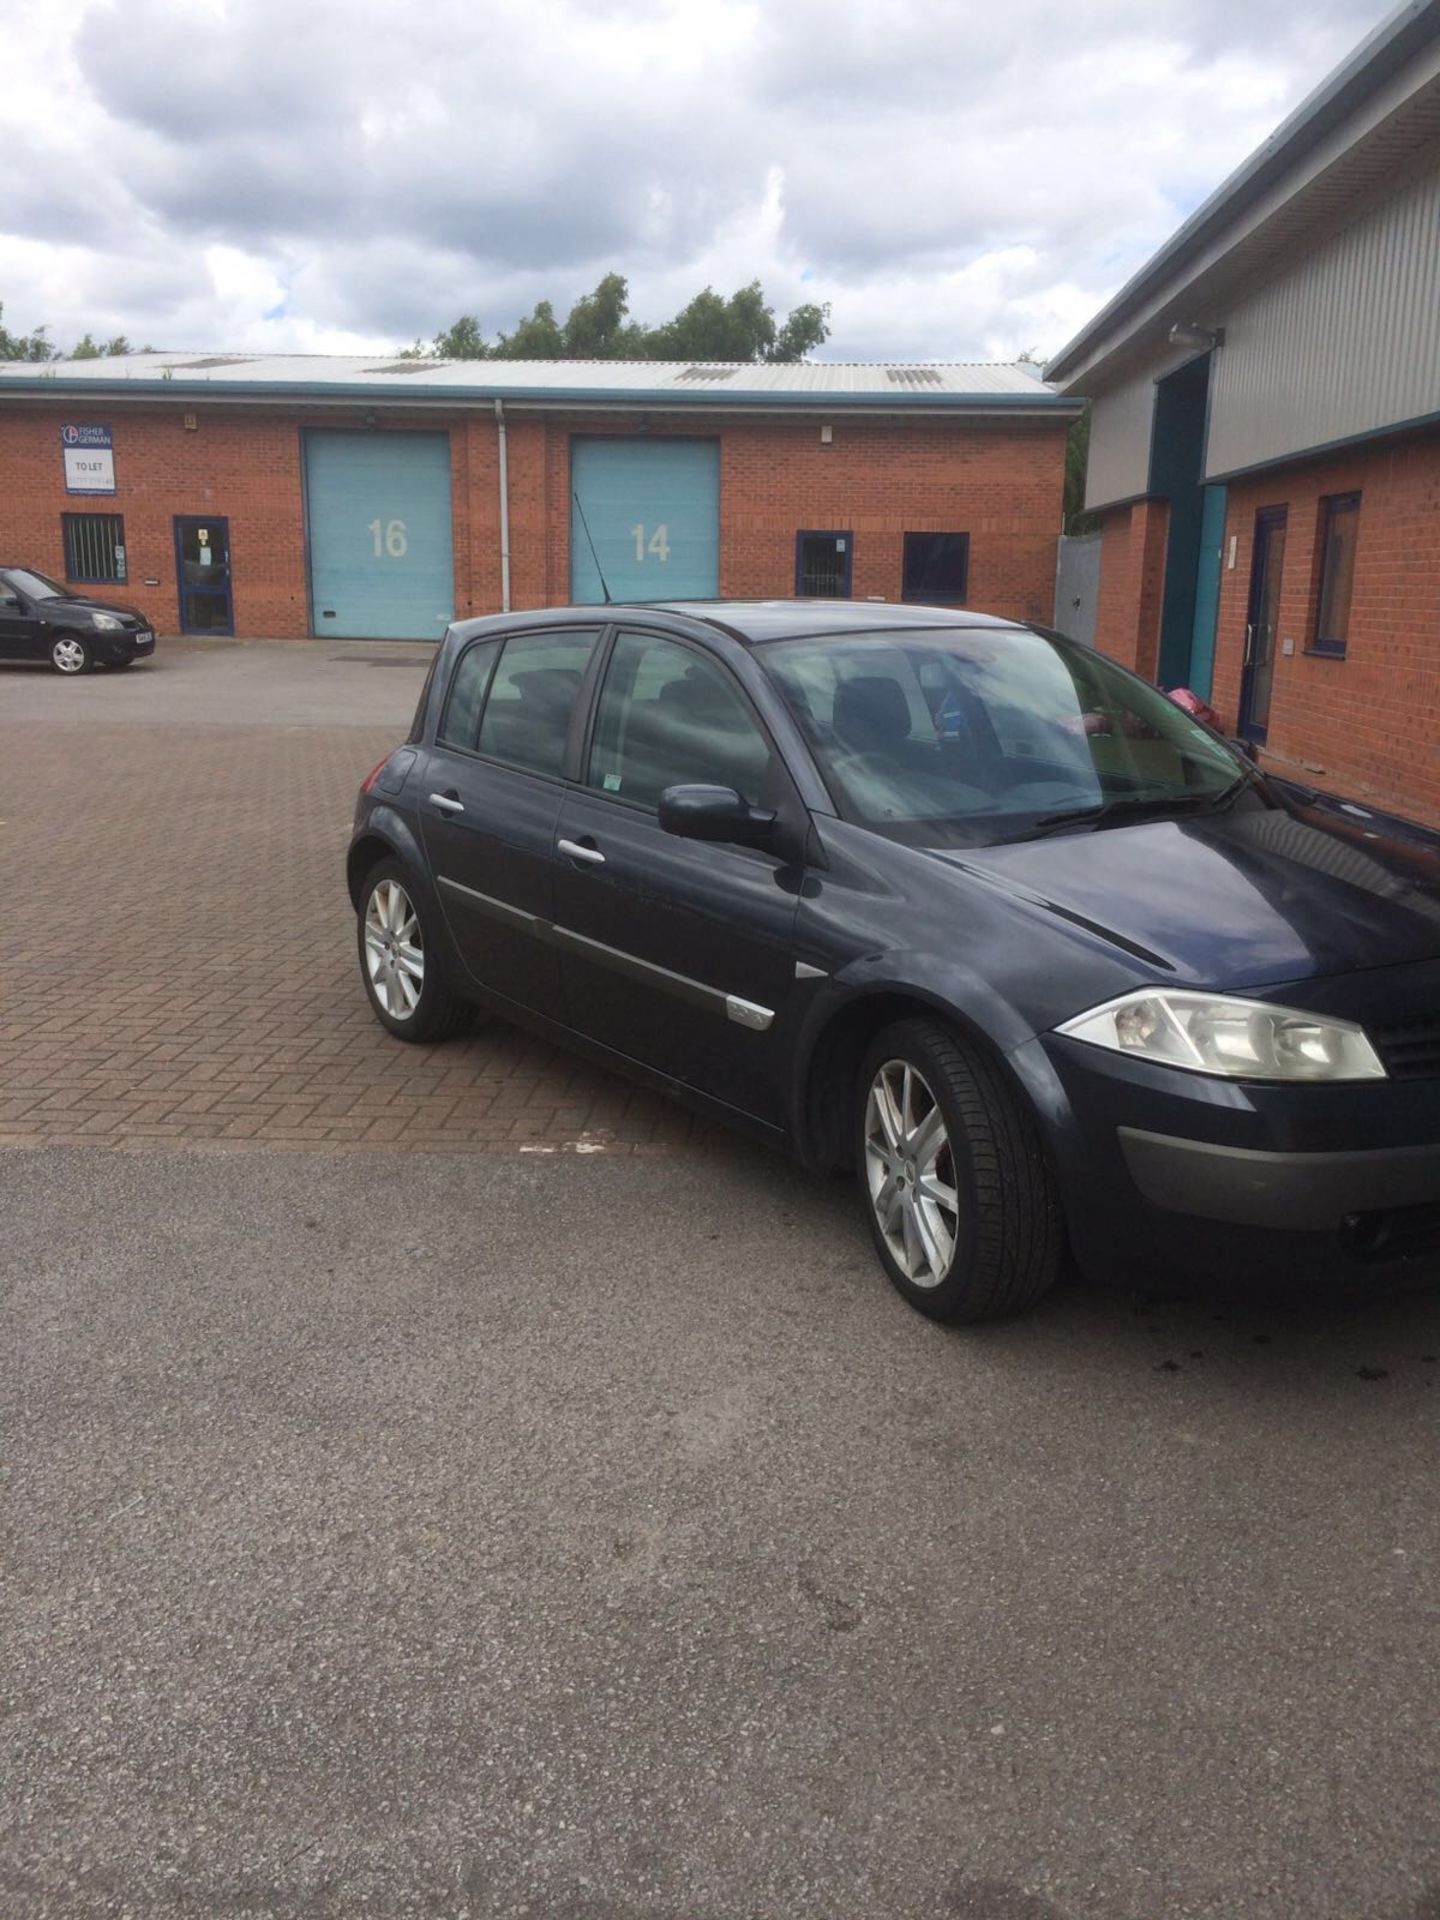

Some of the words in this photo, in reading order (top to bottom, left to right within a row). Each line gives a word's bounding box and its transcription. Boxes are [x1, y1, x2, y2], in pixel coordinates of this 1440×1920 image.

[79, 427, 104, 435] FISHER
[76, 462, 87, 471] TO
[89, 462, 103, 471] LET
[368, 519, 408, 558] 16
[631, 523, 671, 562] 14
